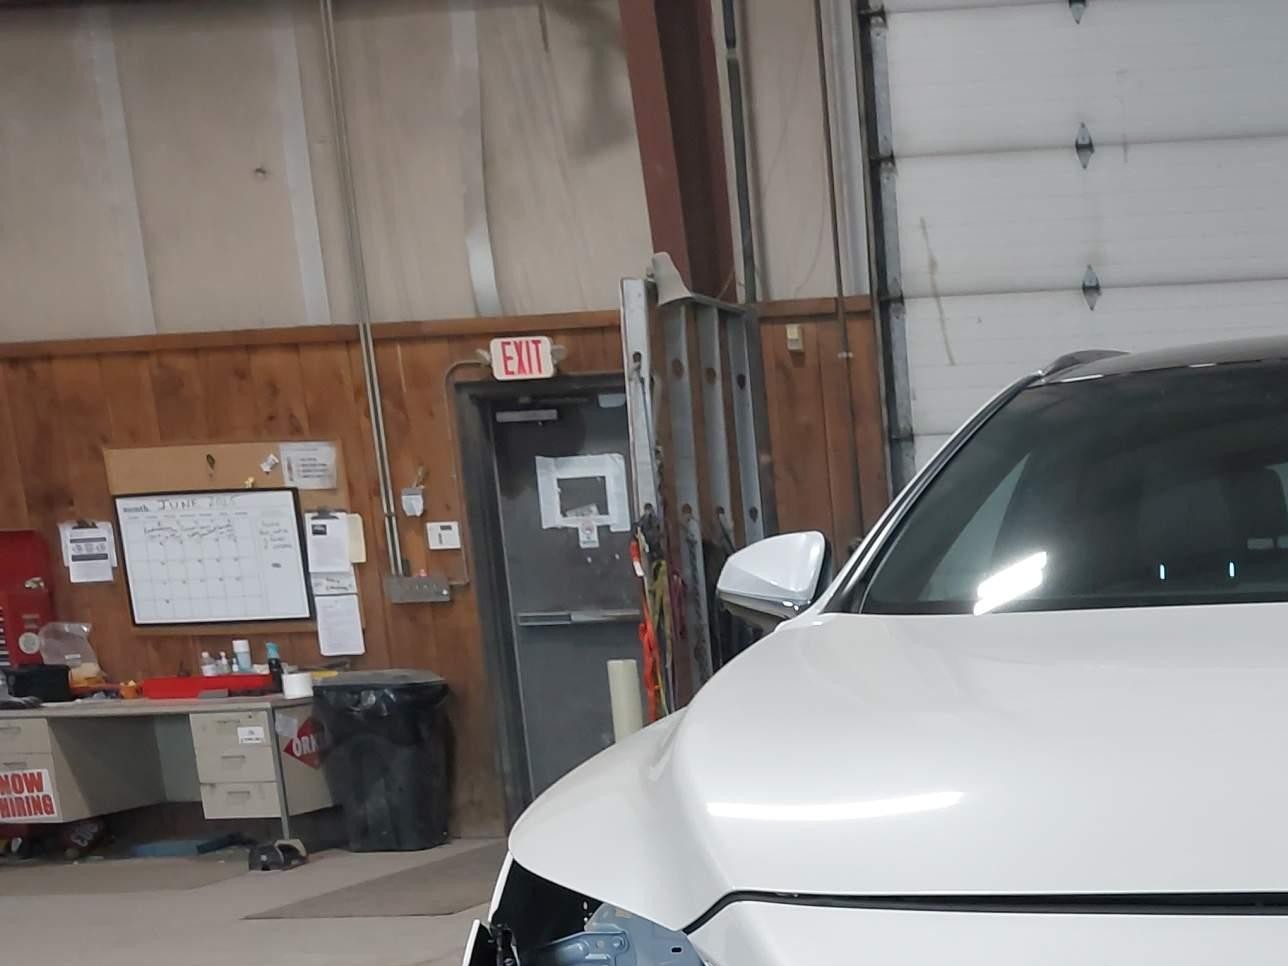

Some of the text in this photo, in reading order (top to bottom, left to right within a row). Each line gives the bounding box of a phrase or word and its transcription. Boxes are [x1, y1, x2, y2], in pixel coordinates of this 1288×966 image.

[501, 339, 543, 375] EXIT
[0, 771, 44, 796] NOW
[0, 794, 56, 819] HIRING
